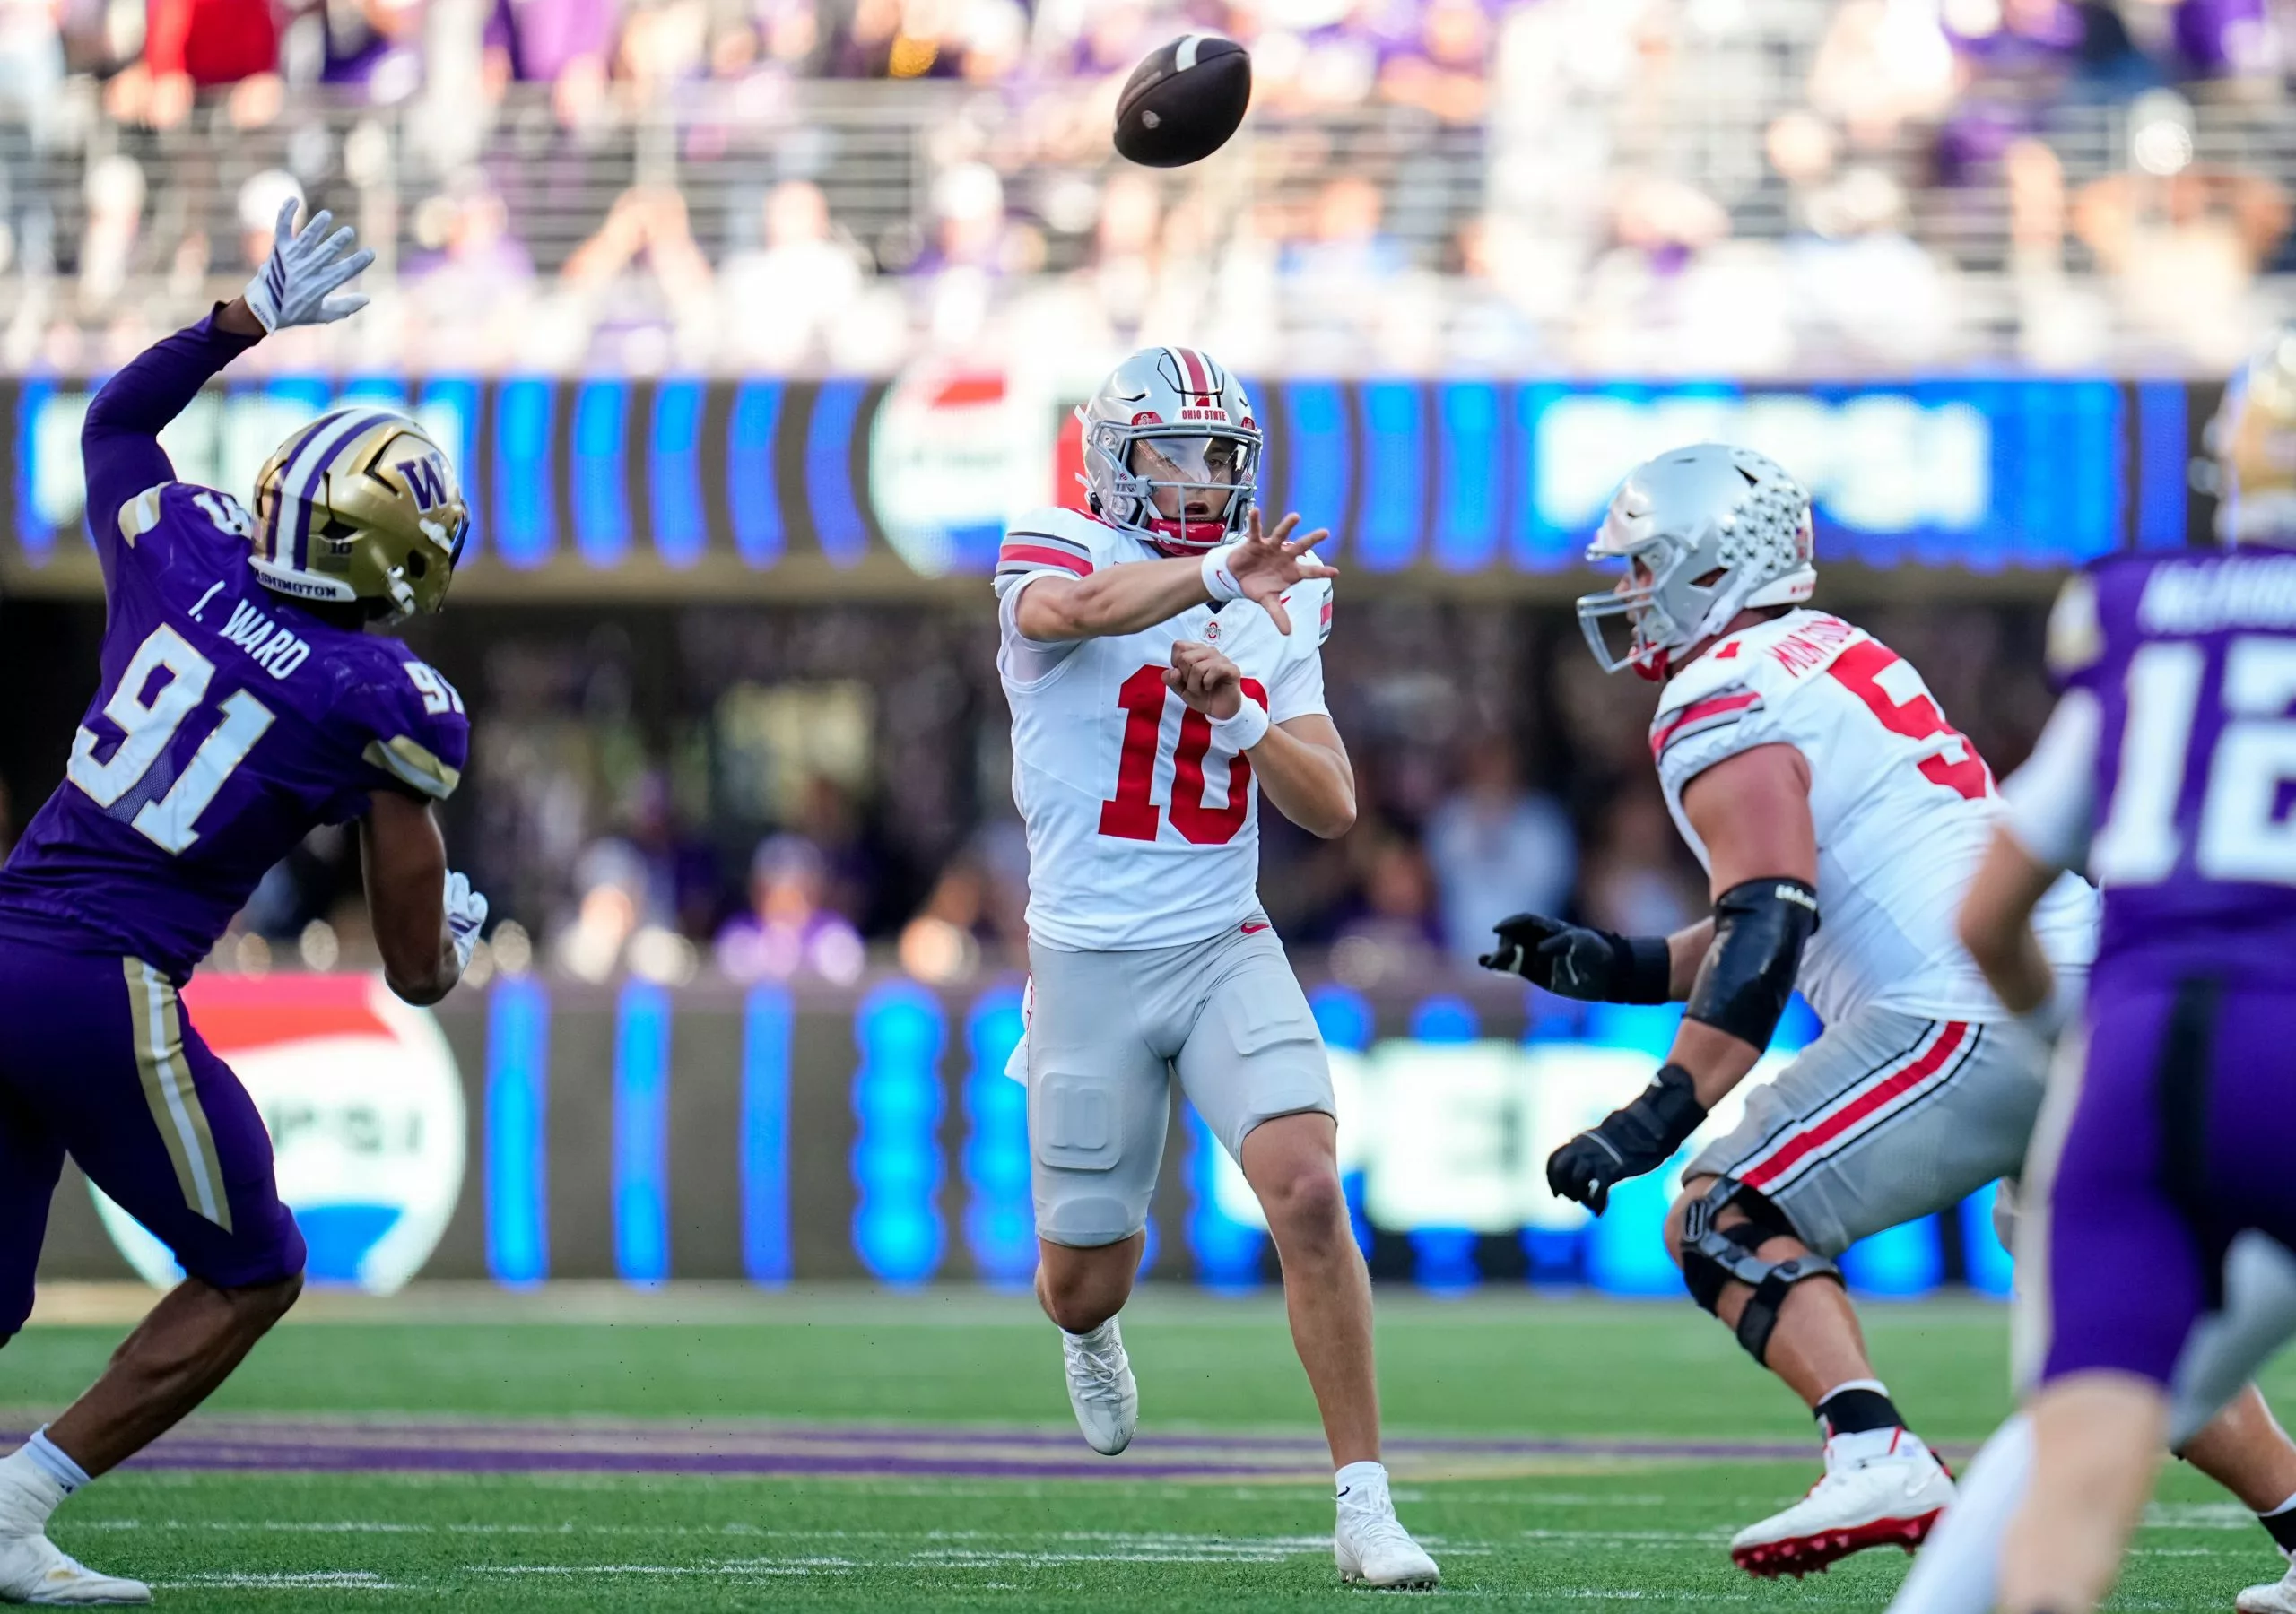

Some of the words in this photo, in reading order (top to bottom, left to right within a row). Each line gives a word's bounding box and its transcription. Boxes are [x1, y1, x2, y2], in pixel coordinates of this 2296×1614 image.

[1181, 409, 1202, 420] OHIO
[1205, 410, 1227, 421] STATE
[395, 450, 448, 514] W
[253, 566, 337, 598] ASHINGTON
[217, 597, 311, 680] WARD
[65, 621, 278, 857] 91
[1098, 664, 1269, 845] 10
[1825, 639, 1993, 801] 5
